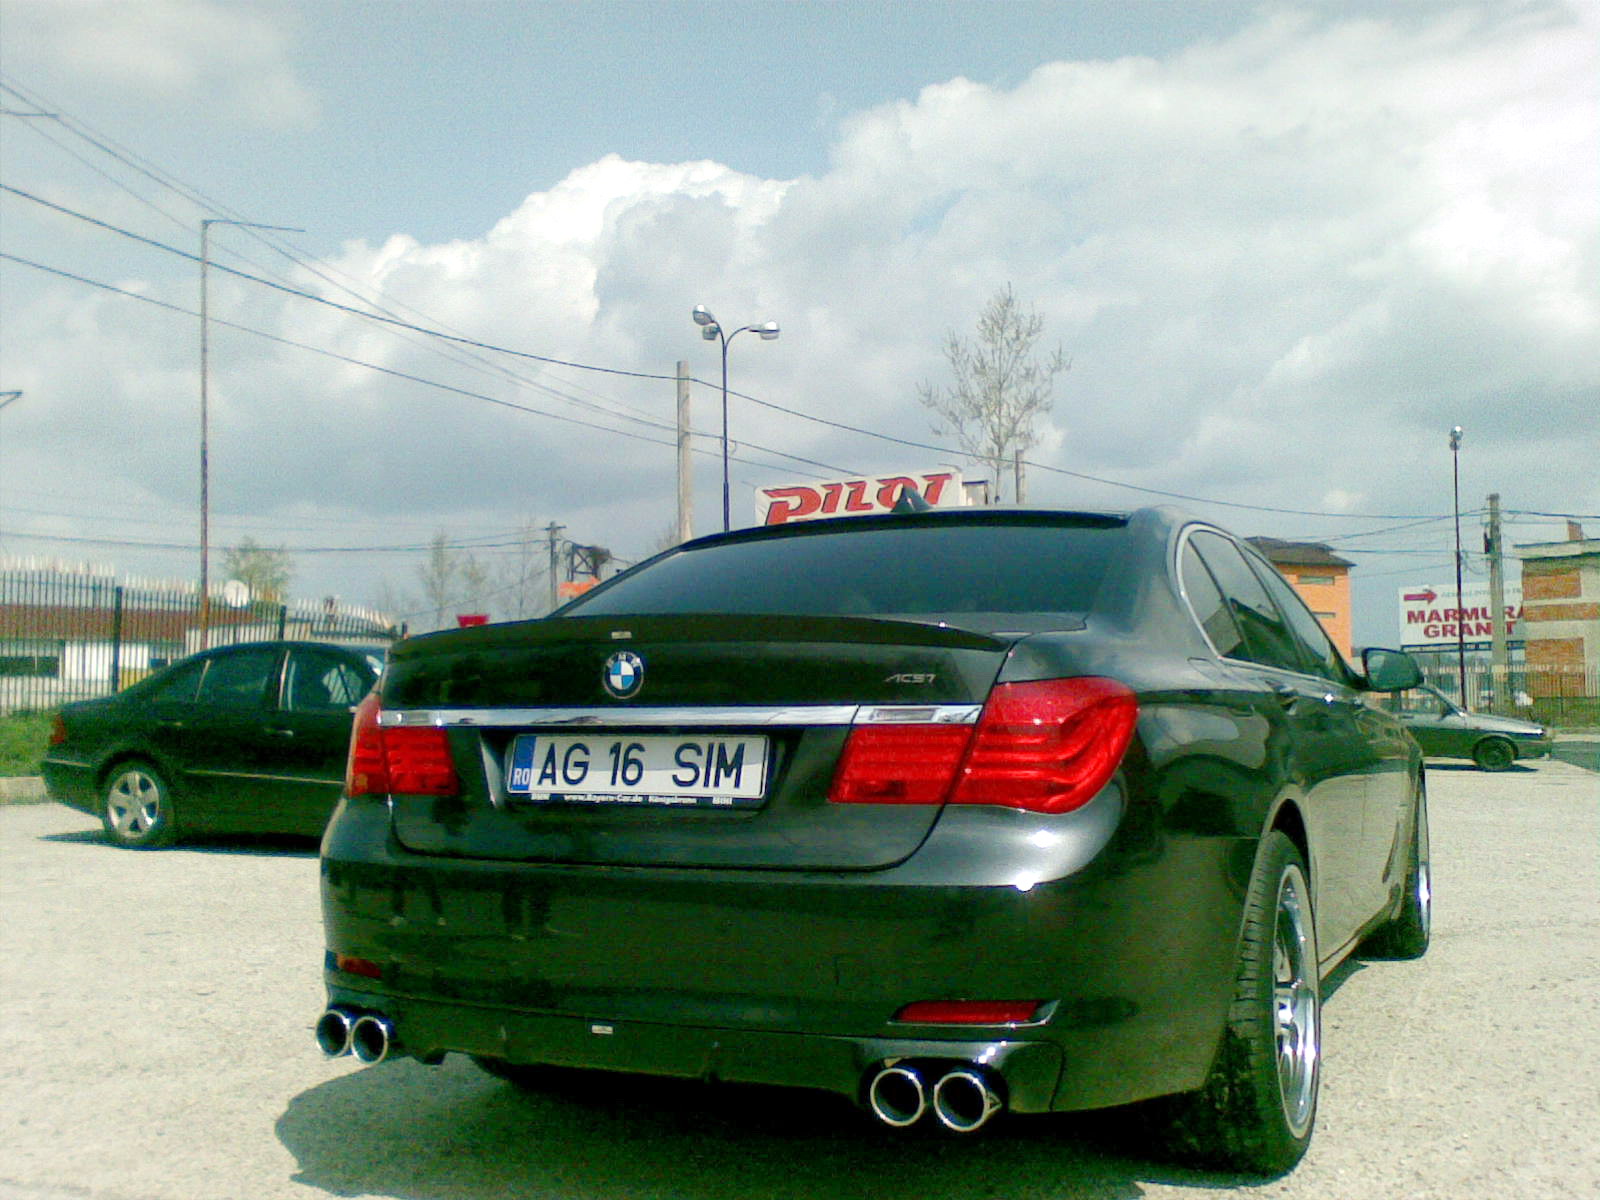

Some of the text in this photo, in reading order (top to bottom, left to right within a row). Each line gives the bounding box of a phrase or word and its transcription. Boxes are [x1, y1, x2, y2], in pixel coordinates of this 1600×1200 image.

[762, 473, 953, 526] PILOT
[1424, 621, 1517, 638] GRANT
[513, 767, 530, 785] RO
[537, 741, 746, 789] AG 16 SIM
